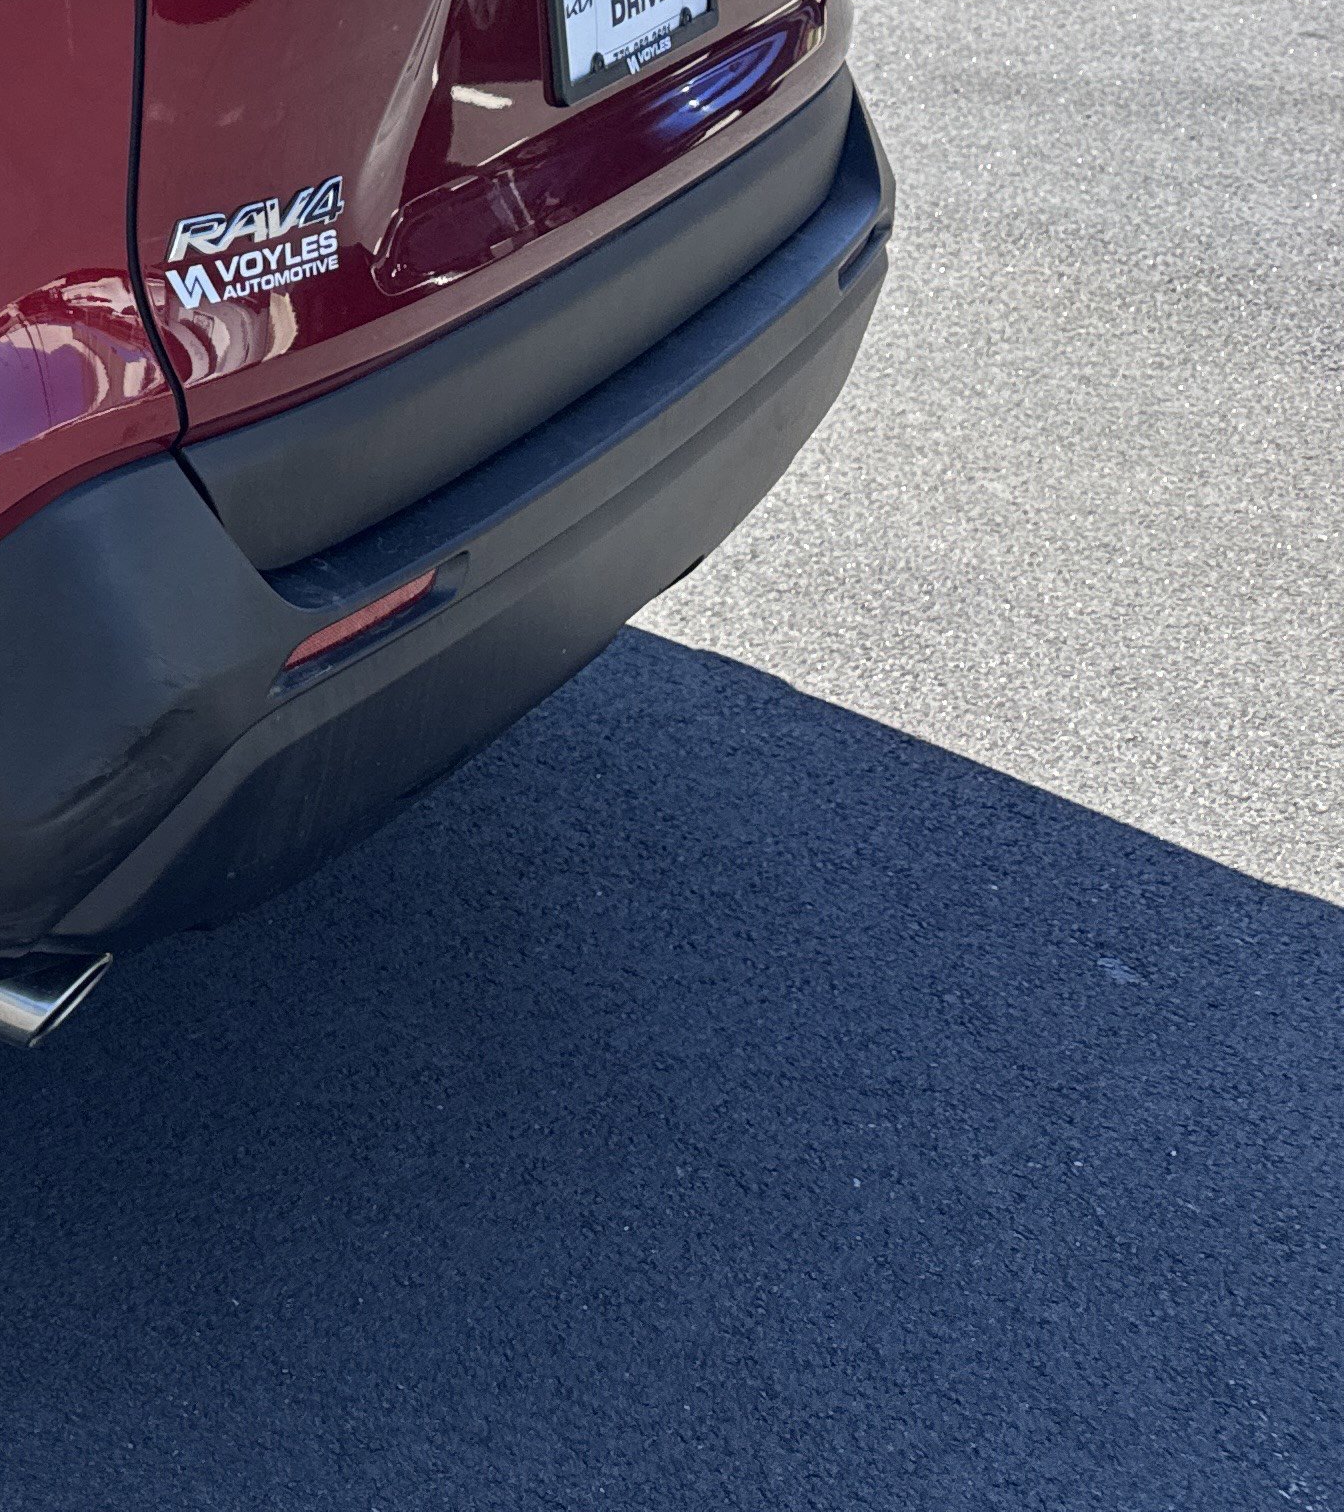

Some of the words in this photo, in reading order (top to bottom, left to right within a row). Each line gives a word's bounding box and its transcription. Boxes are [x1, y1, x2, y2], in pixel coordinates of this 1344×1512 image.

[638, 36, 672, 64] VOYLES
[166, 175, 345, 263] RAV4
[215, 229, 338, 282] VOYLES
[223, 254, 339, 300] AUTOMOTIVE
